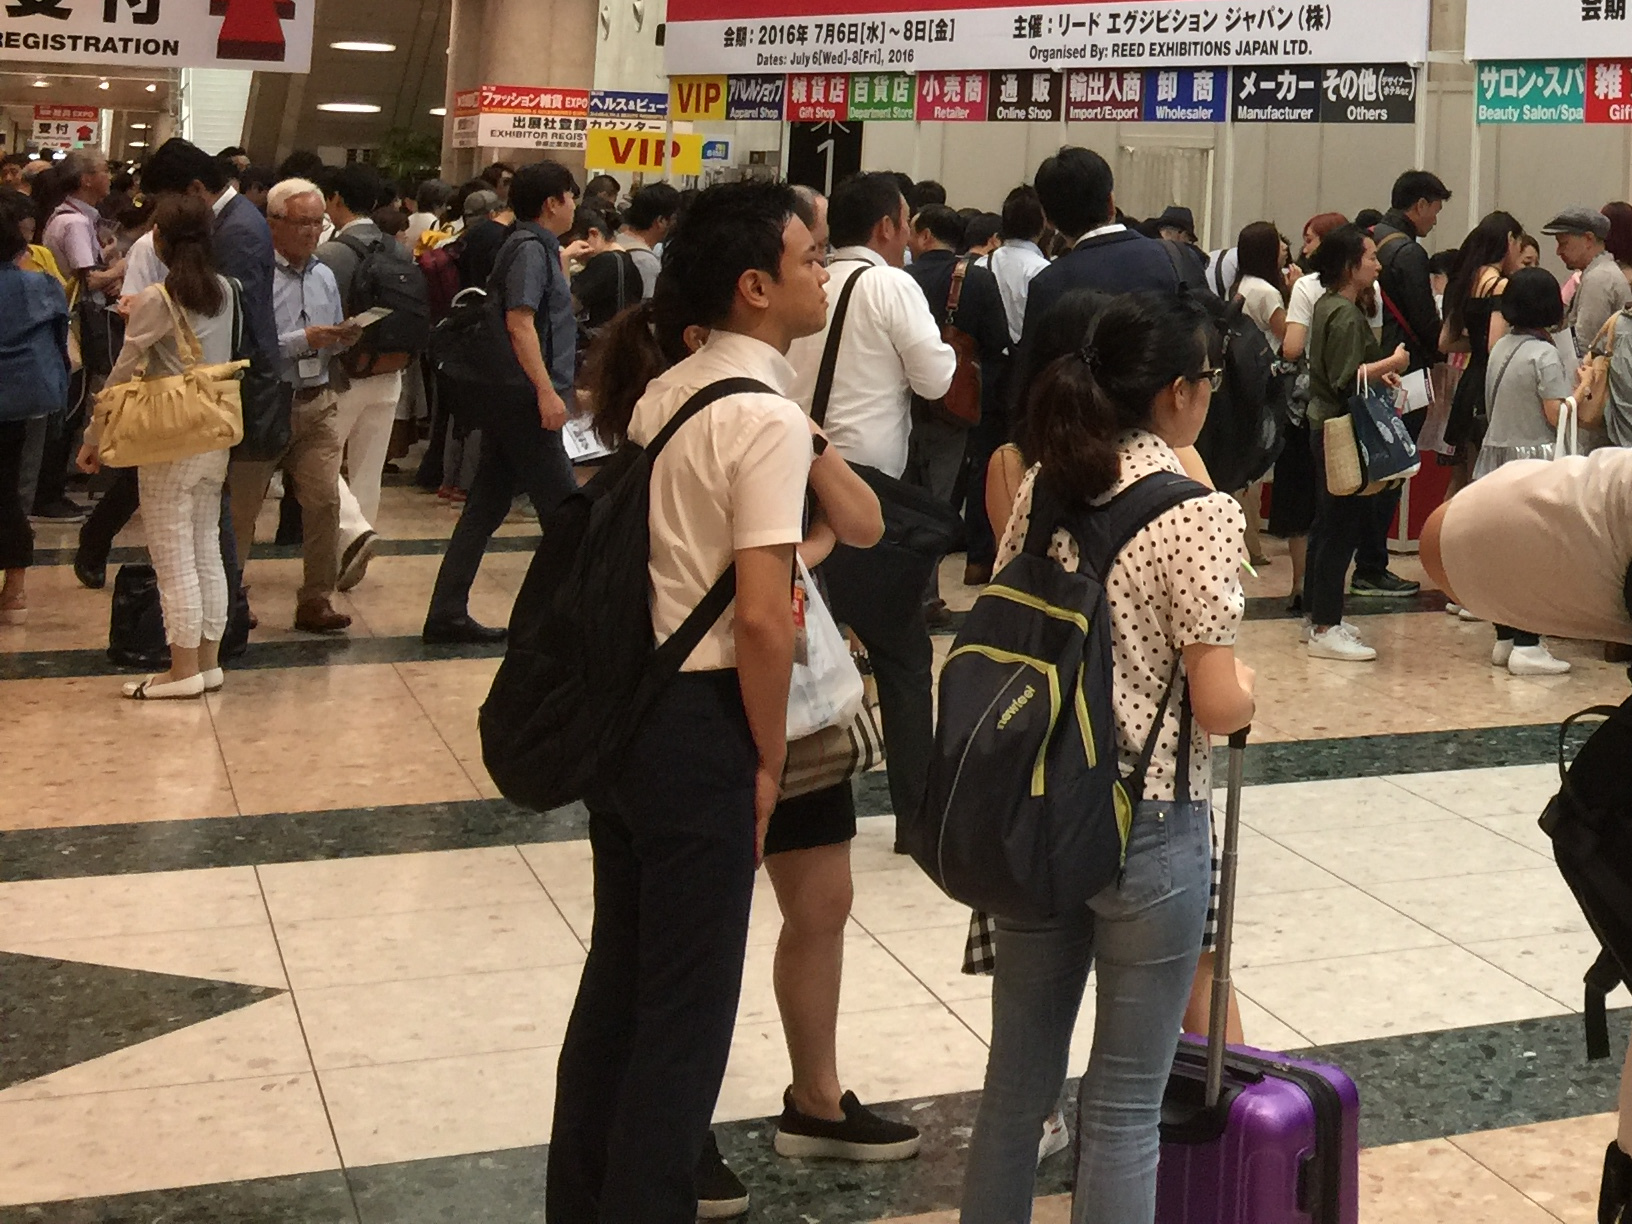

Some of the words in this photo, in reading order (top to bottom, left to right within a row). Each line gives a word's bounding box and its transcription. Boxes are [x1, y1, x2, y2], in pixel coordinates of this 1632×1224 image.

[1107, 9, 1218, 34] エグジビション
[0, 32, 180, 56] EGISTRATION
[1029, 44, 1086, 62] Organised
[1090, 44, 1108, 61] By:
[1112, 41, 1145, 58] REED
[1149, 40, 1231, 57] EXHIBITIONS
[1235, 39, 1279, 56] JAPAN
[1283, 38, 1313, 56] LTD.
[757, 52, 787, 66] Dates:
[888, 49, 914, 64] 2016
[792, 77, 845, 104] 雑貨店
[854, 75, 909, 103] 百貨店
[922, 74, 982, 103] 小売商
[1000, 74, 1051, 102] 通販
[1070, 72, 1141, 103] 輸出入商
[1157, 70, 1213, 102] 卸商
[1239, 69, 1315, 100] メーカー
[1480, 64, 1585, 100] サロン・スパ
[565, 96, 588, 109] EXPO
[591, 97, 668, 113] ヘルス&ビュー
[678, 83, 721, 113] VIP
[730, 107, 758, 119] Apparel
[760, 107, 779, 119] Shop
[799, 106, 814, 118] Gift
[815, 106, 835, 119] Shop
[850, 106, 892, 120] Department
[894, 106, 913, 118] Store
[934, 106, 970, 119] Retailer
[996, 106, 1026, 120] Online
[1028, 106, 1052, 121] Shop
[1069, 106, 1139, 121] Import/Export
[1156, 106, 1213, 121] Wholesaler
[1238, 106, 1313, 121] Manufacturer
[1346, 105, 1388, 120] Others
[1478, 104, 1519, 122] Beauty
[1522, 104, 1584, 121] Salon/Spa
[490, 130, 548, 140] EXHIBITOR
[608, 136, 682, 166] VIP
